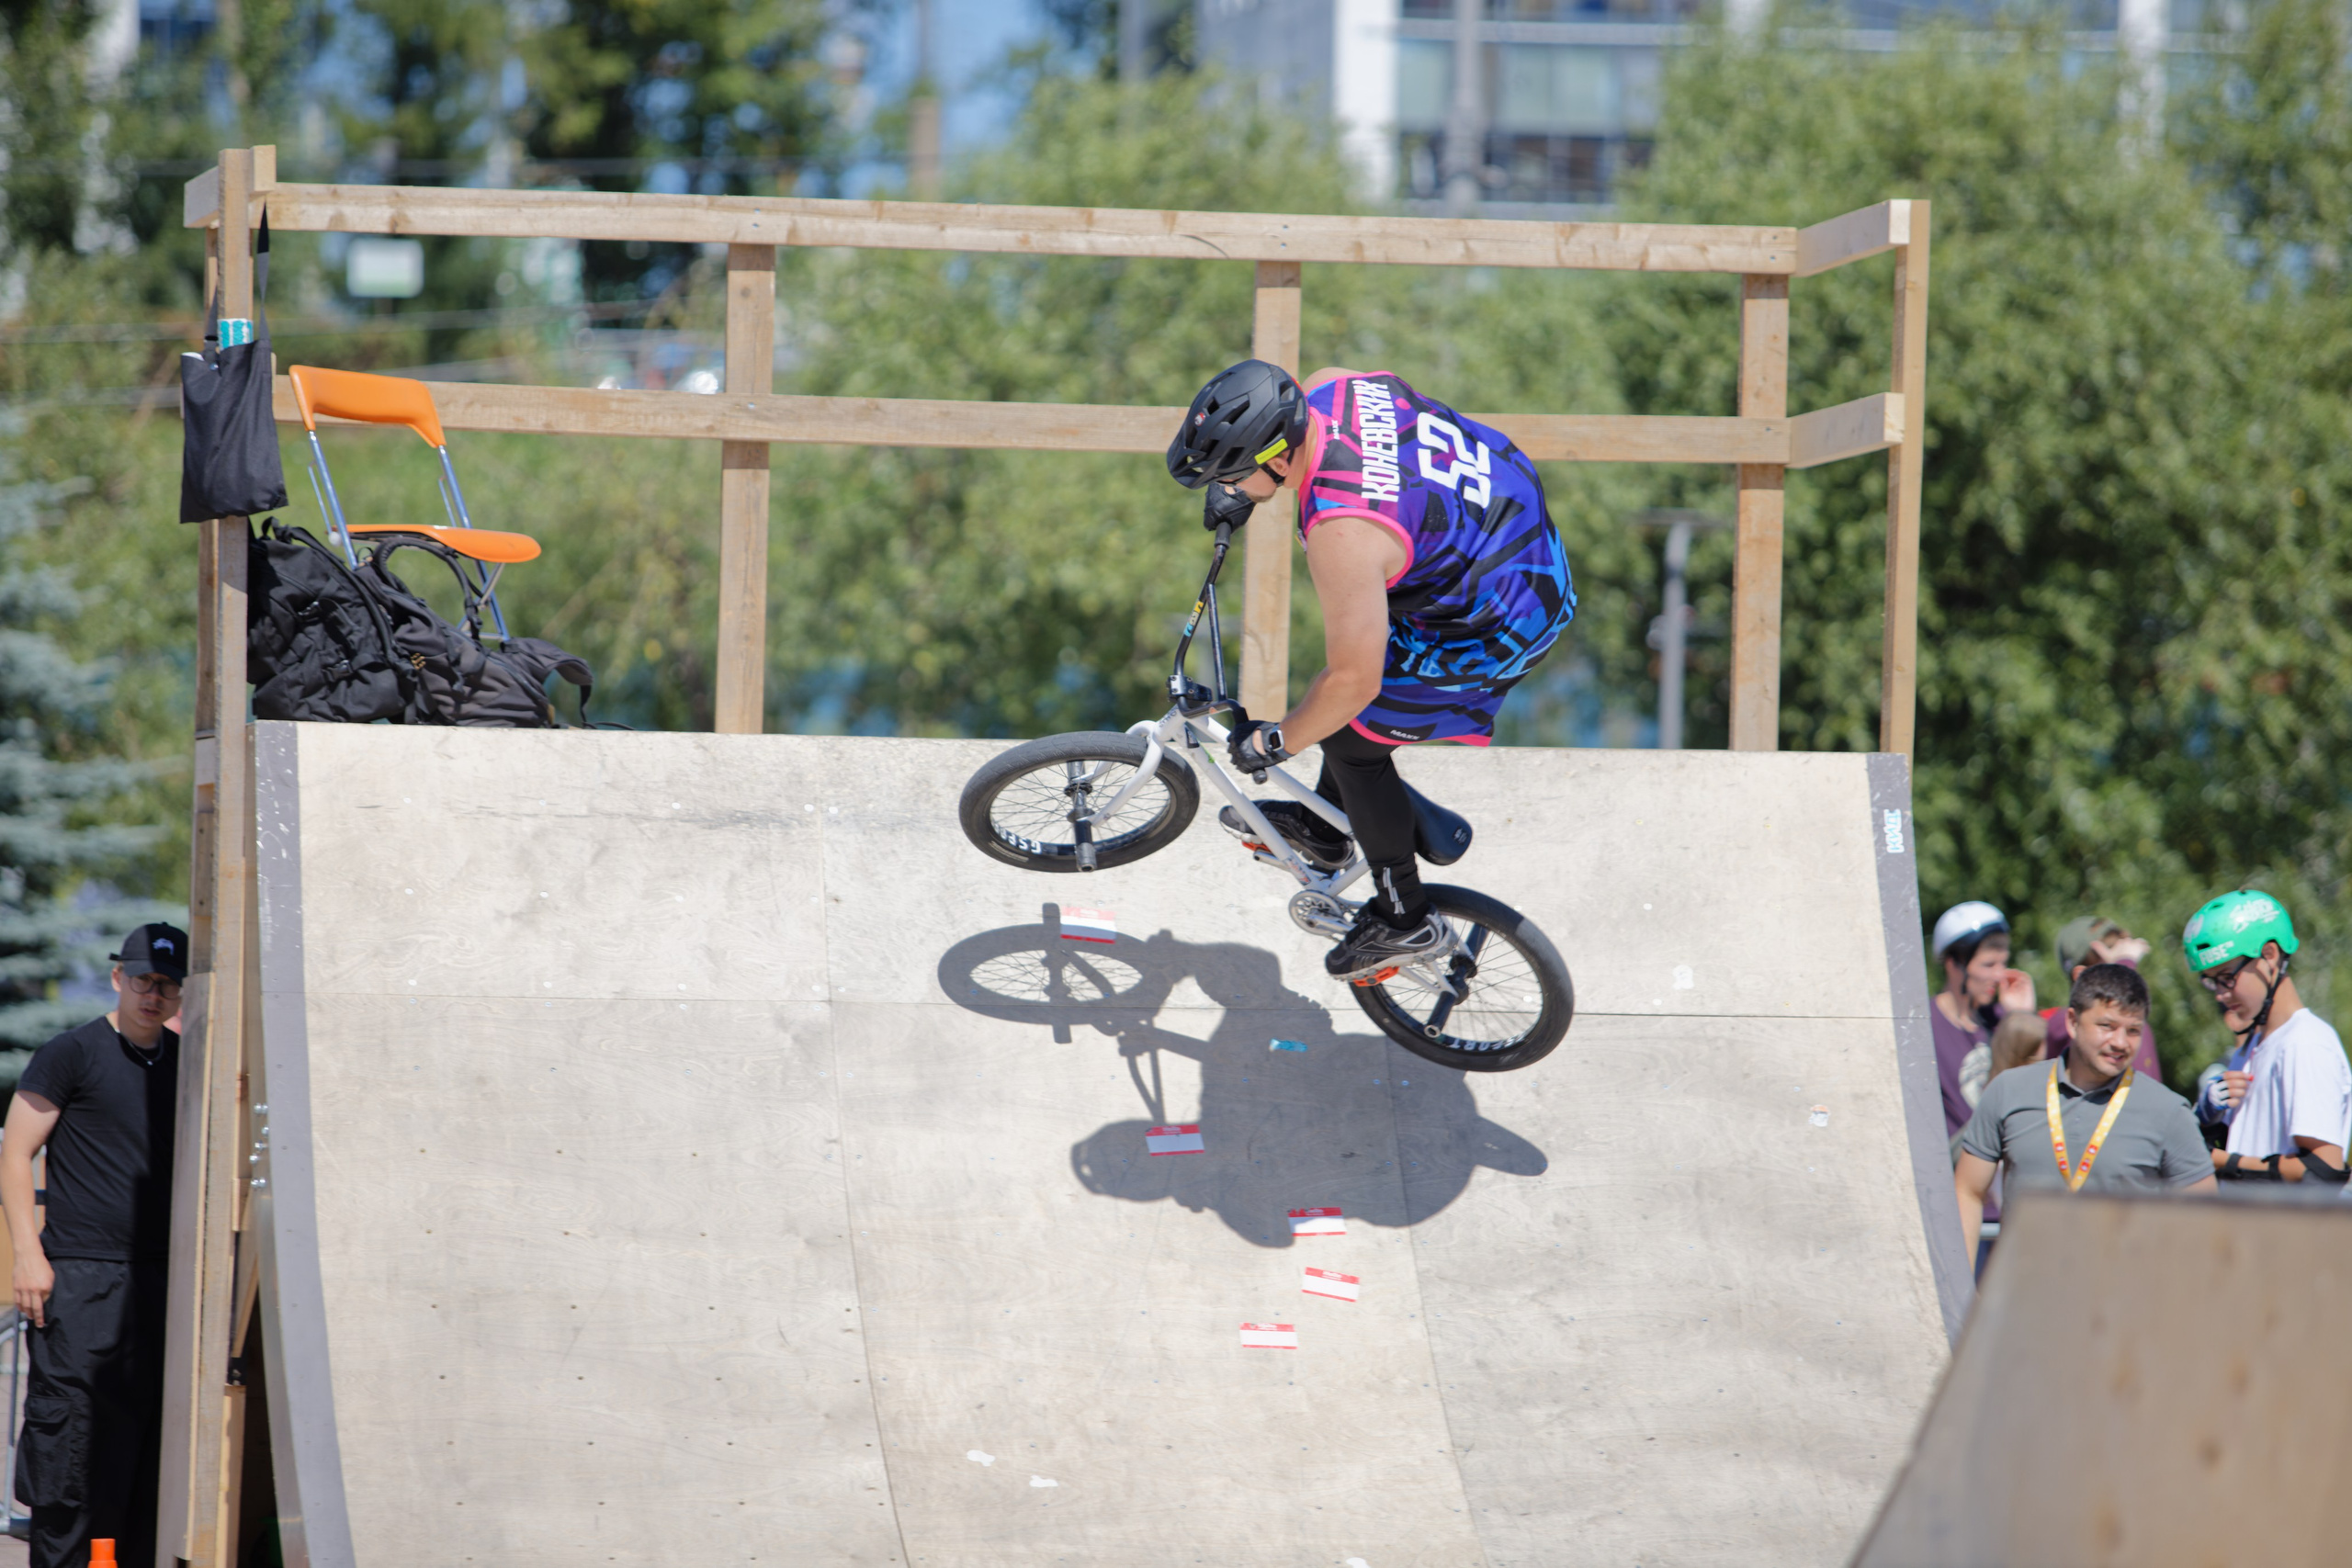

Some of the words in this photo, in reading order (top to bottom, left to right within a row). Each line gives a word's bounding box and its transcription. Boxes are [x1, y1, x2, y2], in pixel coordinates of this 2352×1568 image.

[1351, 378, 1401, 502] КОНЕВСКИХ
[1417, 412, 1492, 509] 52
[1389, 728, 1420, 741] MAXX
